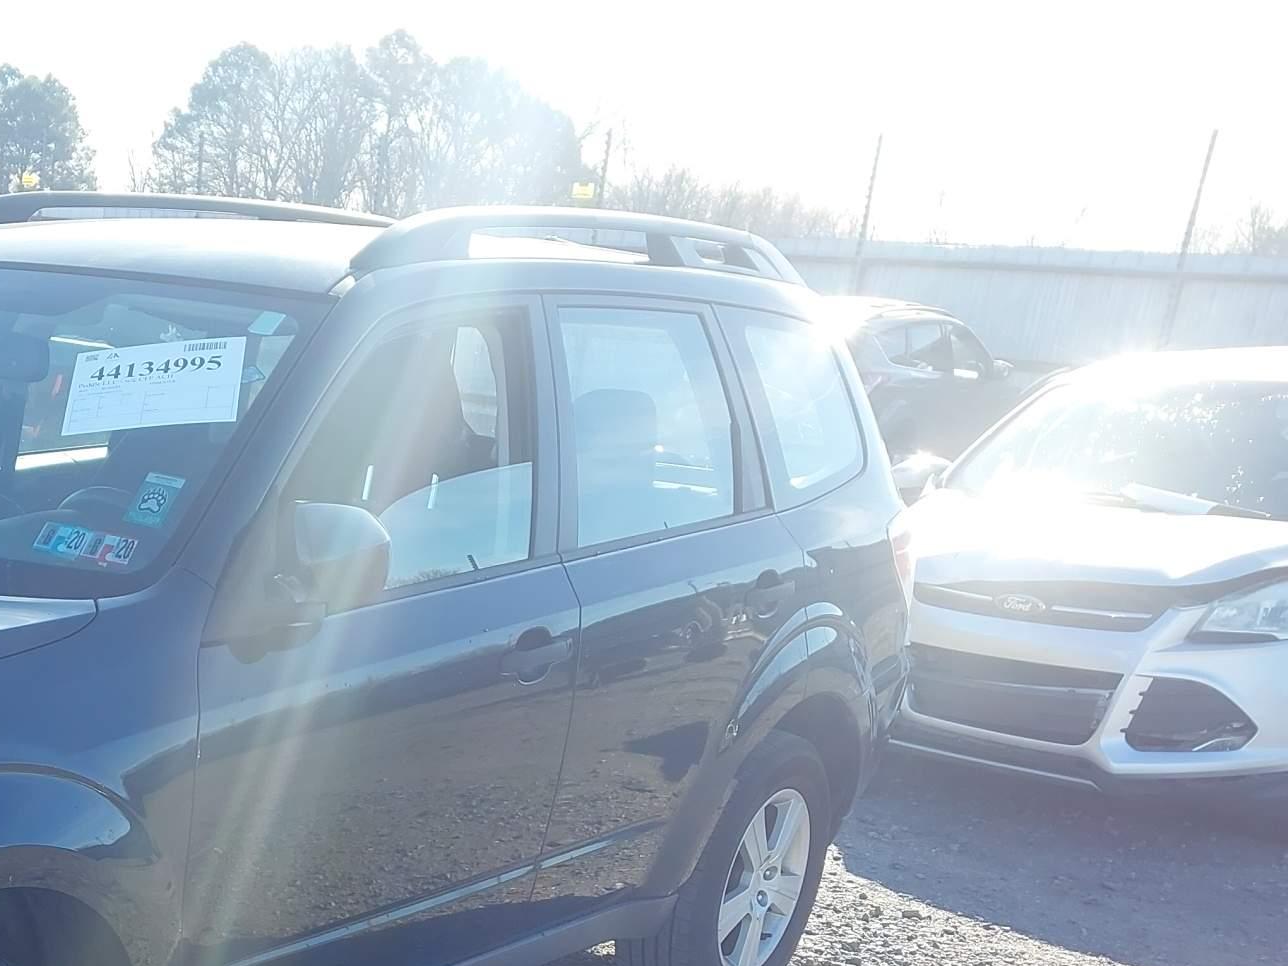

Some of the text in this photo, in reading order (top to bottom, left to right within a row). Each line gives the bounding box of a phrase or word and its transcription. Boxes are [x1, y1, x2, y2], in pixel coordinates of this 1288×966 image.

[90, 355, 223, 381] 44134995
[66, 530, 86, 550] 20
[115, 538, 135, 559] 20
